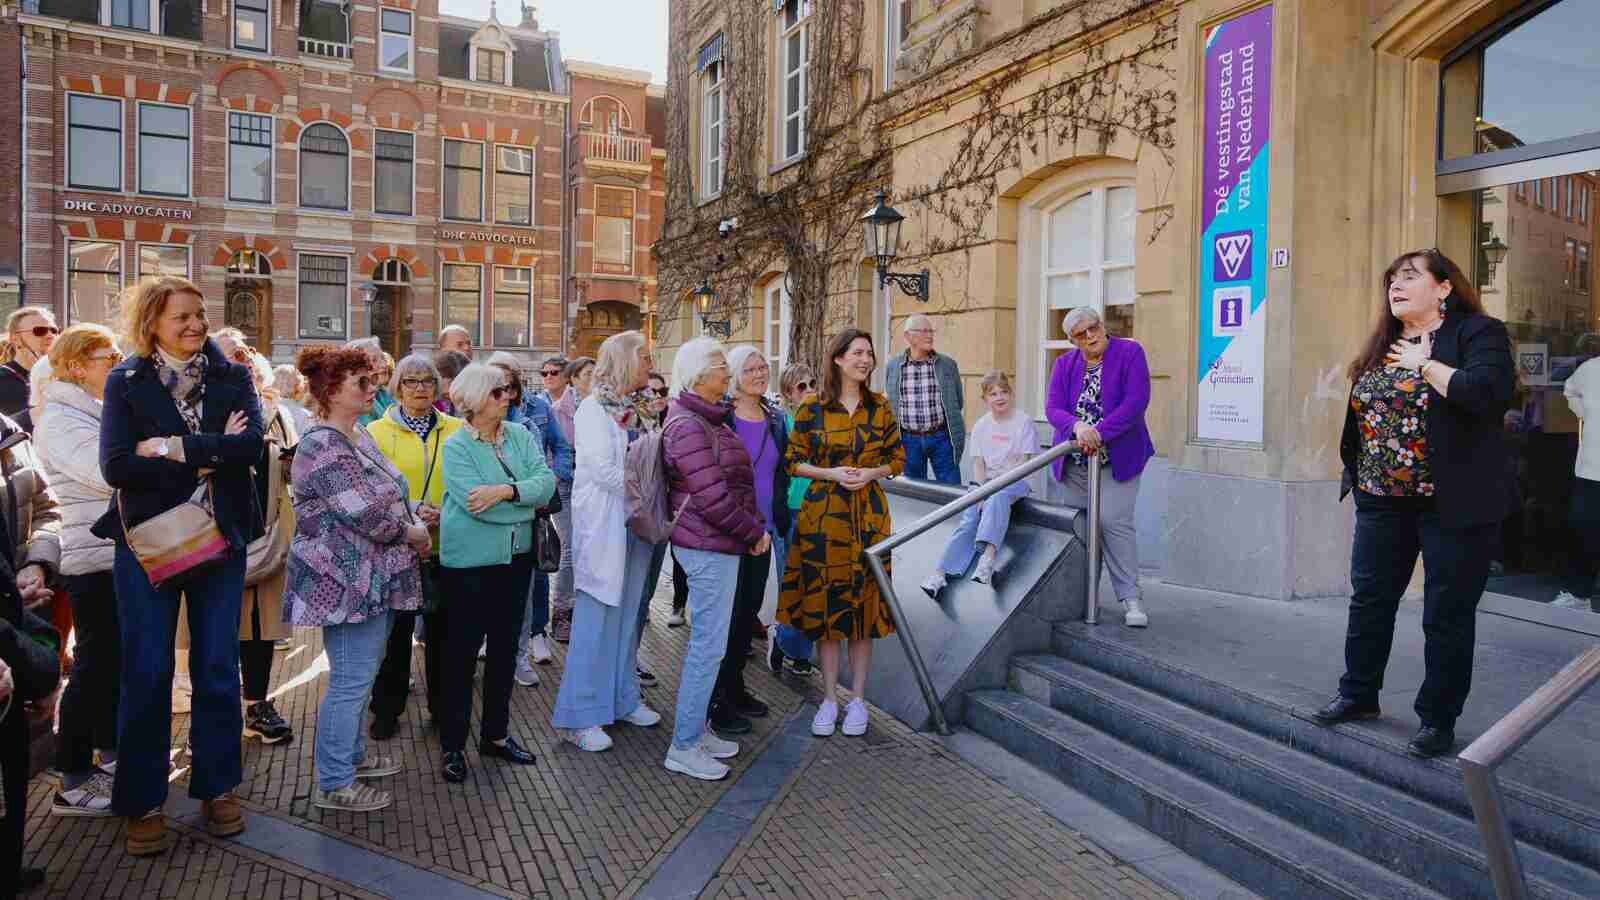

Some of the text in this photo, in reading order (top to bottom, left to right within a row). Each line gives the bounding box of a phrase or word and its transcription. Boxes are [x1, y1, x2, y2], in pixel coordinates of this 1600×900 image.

[1214, 48, 1235, 217] Dé vestingstad
[1236, 41, 1255, 210] van Nederland
[64, 199, 193, 220] DHC ADVOCATEN
[442, 230, 536, 246] DHC ADVOCATEN
[1275, 249, 1286, 266] 17
